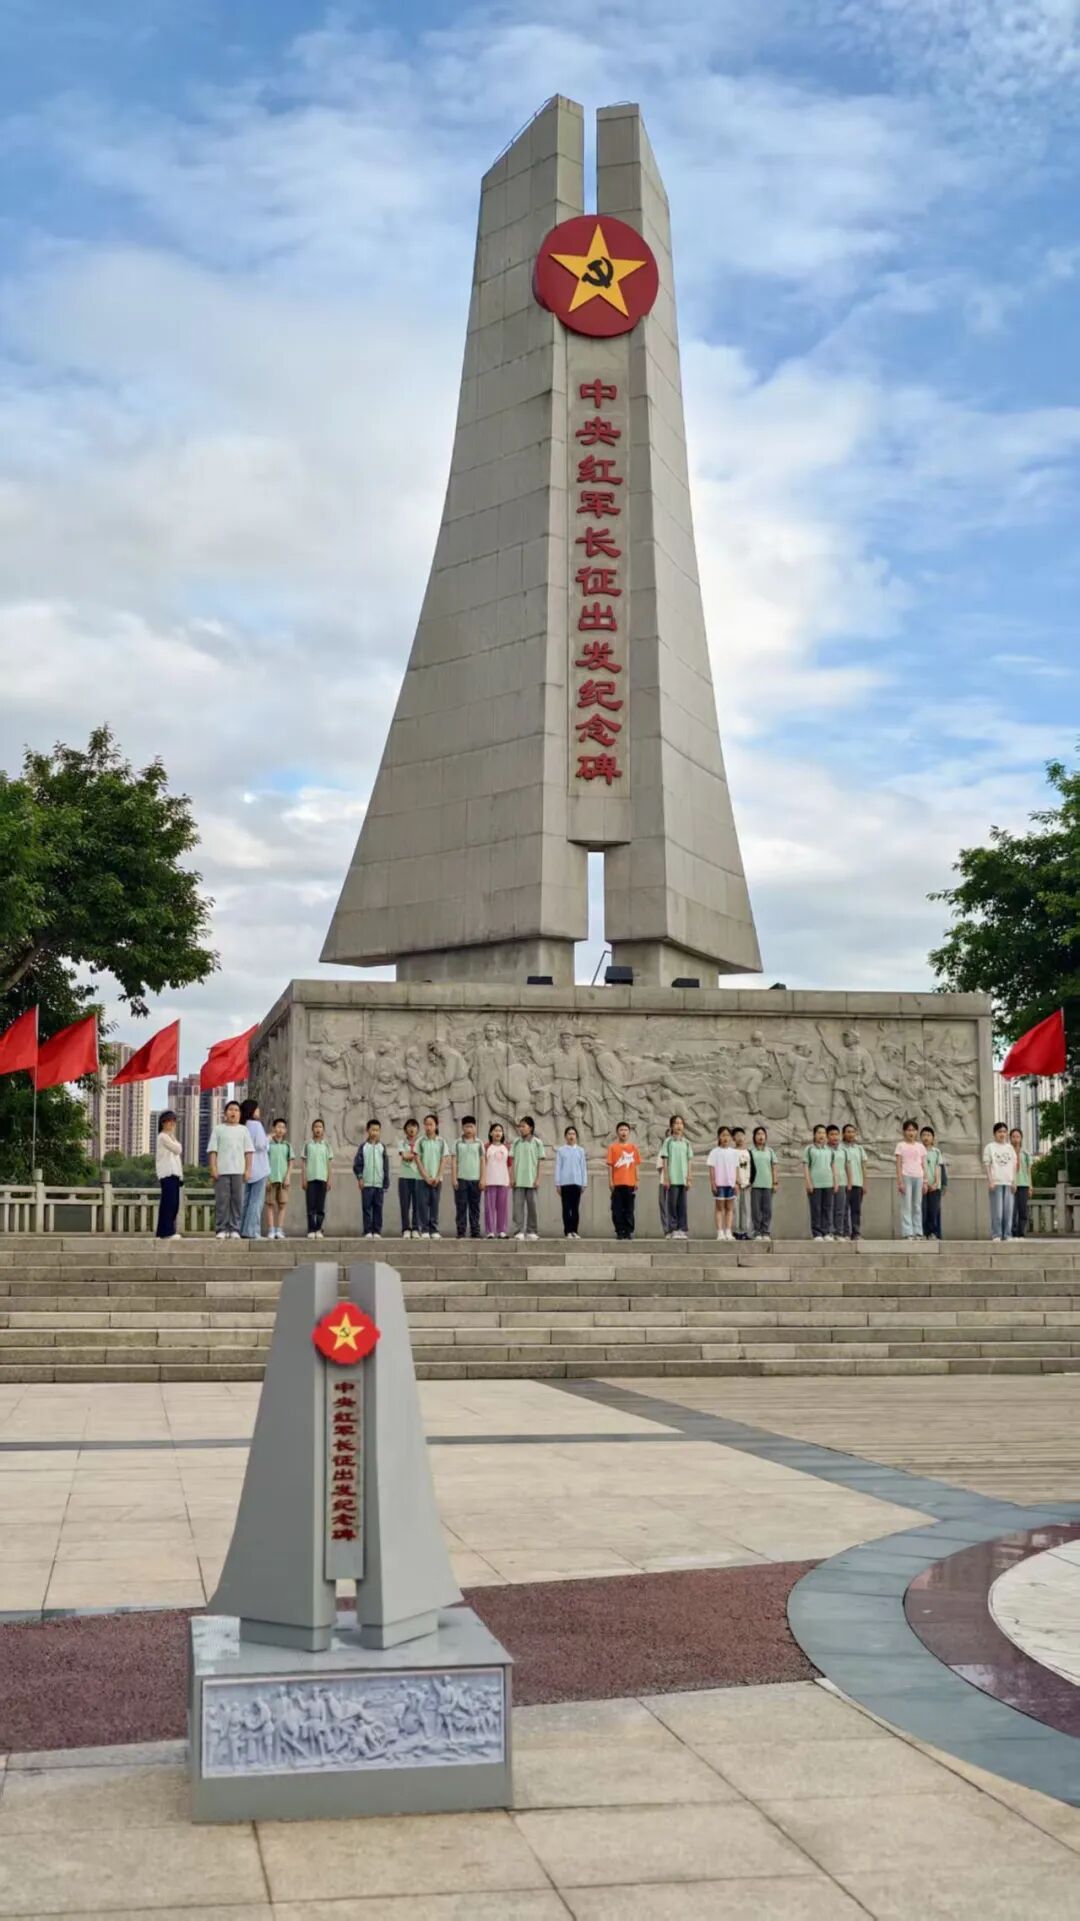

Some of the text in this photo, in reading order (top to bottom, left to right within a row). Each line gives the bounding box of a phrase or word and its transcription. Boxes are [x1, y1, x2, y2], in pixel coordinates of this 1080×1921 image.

[575, 379, 624, 785] 中央红军长征出发纪念碑
[332, 1381, 357, 1541] 中央红军长征出发纪念碑
